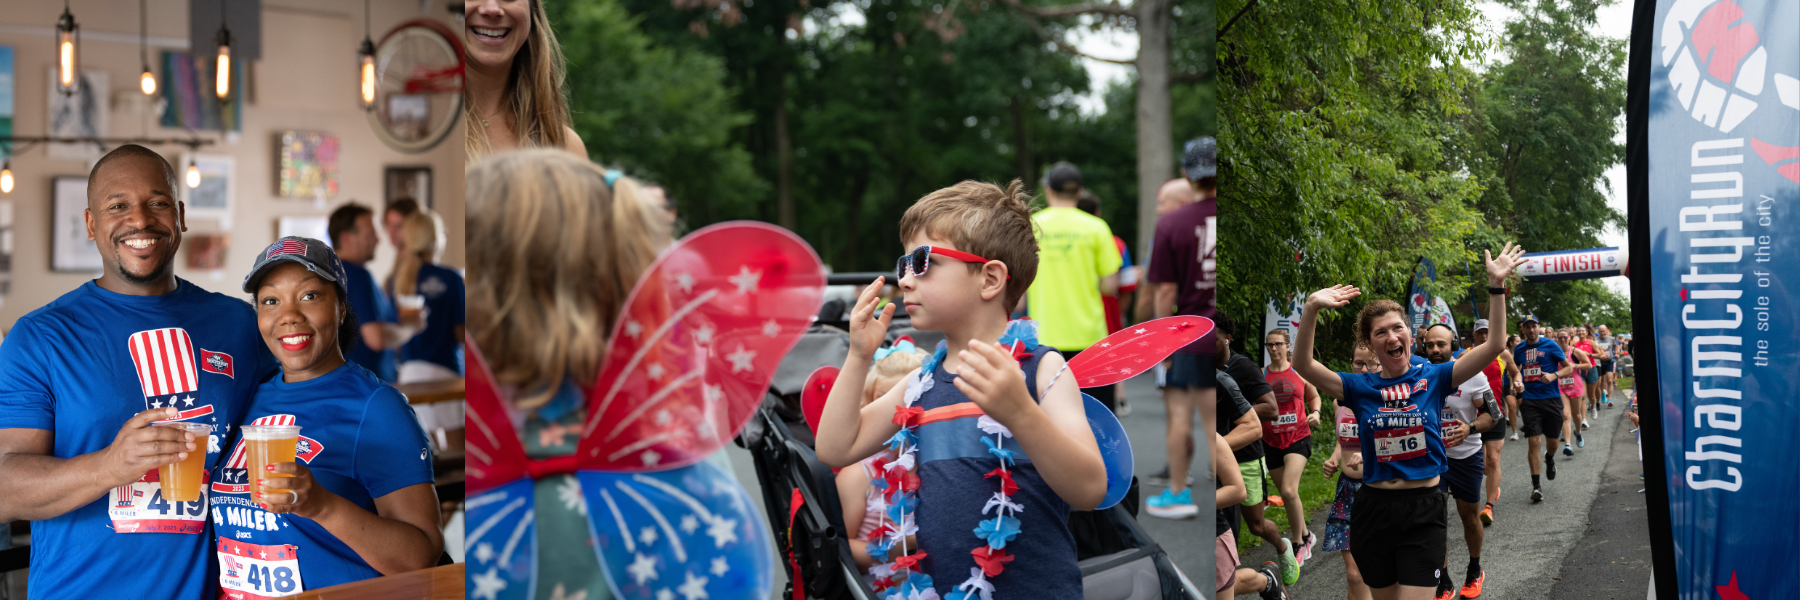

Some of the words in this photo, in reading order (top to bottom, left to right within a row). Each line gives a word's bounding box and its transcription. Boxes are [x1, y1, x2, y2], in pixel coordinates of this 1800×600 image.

[1756, 194, 1775, 227] city
[1754, 235, 1771, 263] the
[1543, 253, 1602, 273] FINISH
[1754, 271, 1770, 288] of
[1753, 296, 1770, 331] sole
[1753, 340, 1769, 367] the
[1280, 415, 1296, 423] 465
[1388, 417, 1423, 428] MILER
[1399, 437, 1418, 451] 16
[212, 506, 224, 527] 4
[226, 506, 280, 532] MILER
[247, 563, 296, 593] 418
